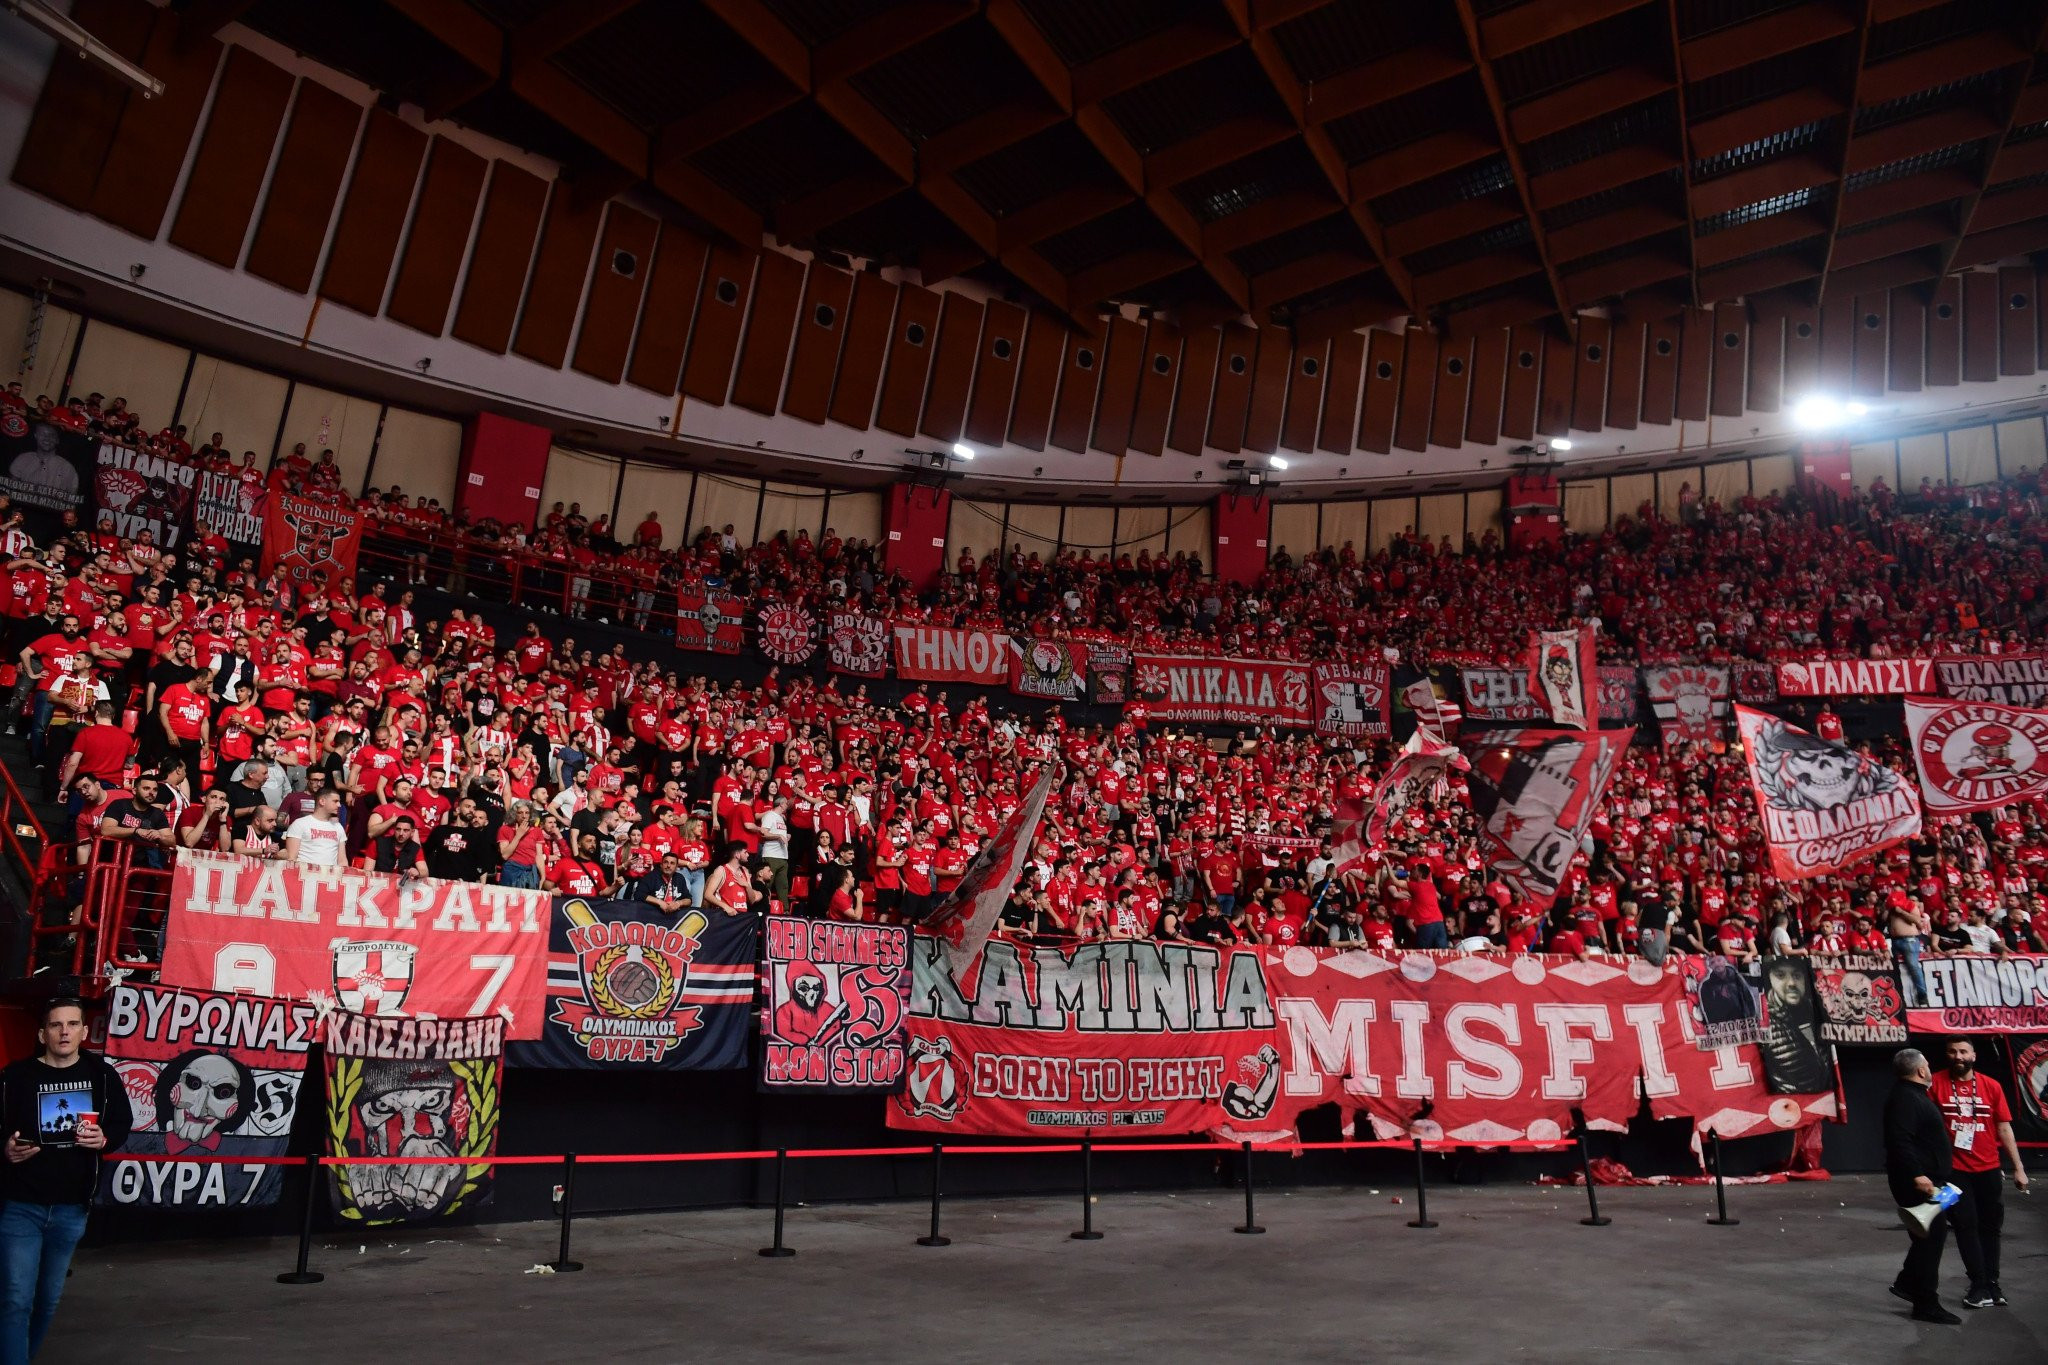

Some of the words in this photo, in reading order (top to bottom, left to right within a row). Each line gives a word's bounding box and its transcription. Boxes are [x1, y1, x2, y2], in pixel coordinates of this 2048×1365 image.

[97, 443, 196, 489] ΑΙΓΑΛΕΩ
[199, 470, 240, 507] ΑΓΙΑ
[280, 495, 355, 525] Koridallos
[167, 525, 180, 548] 7
[758, 603, 818, 627] BRIGADE
[833, 614, 884, 638] ΒΟΥΛΑ
[832, 650, 870, 672] ΘΥΡΑ
[874, 659, 883, 671] 7
[895, 628, 1010, 675] ΤΗΝΟΣ
[1020, 674, 1076, 697] ΛΕΥΚΑΔΑ
[1169, 666, 1277, 708] ΝΙΚΑΙΑ
[1809, 659, 1912, 695] ΓΑΛΑΤΣΙ
[1915, 659, 1933, 691] 7
[1166, 708, 1246, 722] ΟΛΥΜΠΙΑΚΟΣ
[1942, 770, 2048, 800] ΓΑΛΑΤΣΙ
[1766, 788, 1912, 843] ΚΕΦΑΛΟΝΙΑ
[1870, 823, 1888, 843] 7
[186, 856, 541, 934] ΠΑΓΚΡΑΤΙ
[568, 922, 702, 963] ΚΟΛΩΝΟΣ
[768, 918, 809, 961] RED
[812, 922, 908, 967] SICKNESS
[1811, 954, 1842, 970] NEA
[1844, 955, 1894, 971] LIOSIA
[468, 954, 516, 1016] 7
[909, 938, 1277, 1033] KAMINIA
[108, 983, 316, 1052] ΒΥΡΩΝΑΣ
[581, 1017, 677, 1037] ΟΛΥΜΠΙΑΚΟΣ
[1820, 1022, 1907, 1043] OLYMPIAKOS
[326, 1011, 503, 1061] ΚΑΙΣΑΡΙΑΝΗ
[587, 1038, 666, 1062] ΘΥΡΑ-7
[919, 1042, 941, 1055] GATE
[768, 1046, 827, 1082] NON
[833, 1049, 904, 1086] STOP
[973, 1053, 1071, 1101] BORN
[1075, 1057, 1124, 1102] TO
[1128, 1055, 1225, 1101] FIGHT
[1028, 1110, 1107, 1126] OLYMPIAKOS
[1112, 1110, 1165, 1126] PIAEUS
[112, 1160, 226, 1206] ΘΥΡΑ
[239, 1161, 266, 1206] 7
